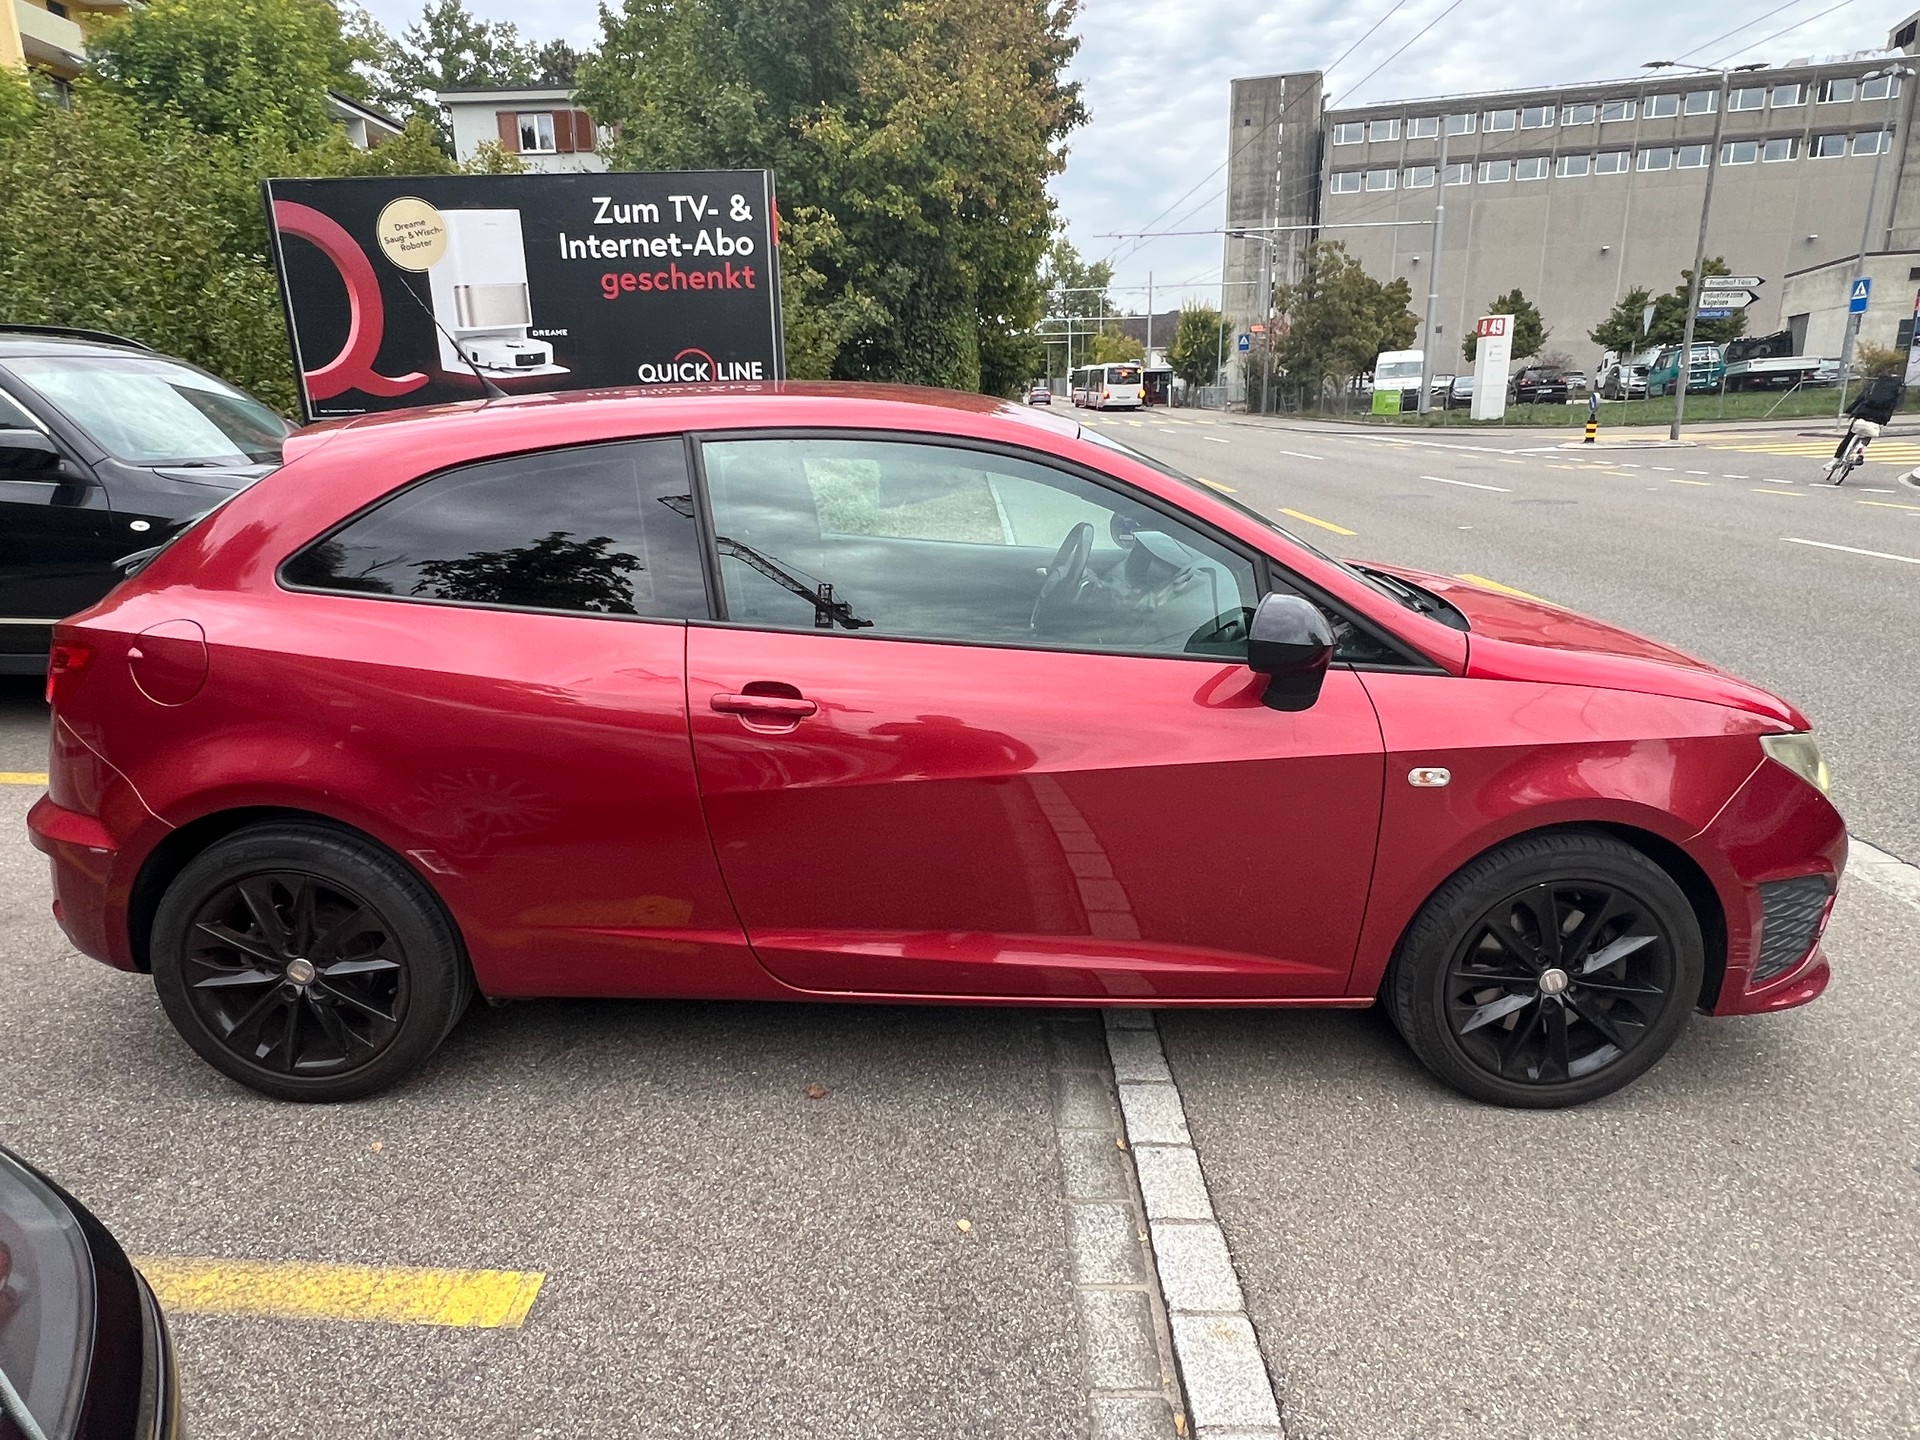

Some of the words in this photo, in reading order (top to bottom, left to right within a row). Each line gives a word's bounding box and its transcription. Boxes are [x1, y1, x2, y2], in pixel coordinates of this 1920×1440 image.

[591, 196, 660, 225] Zum
[667, 194, 719, 223] TV-
[729, 193, 753, 222] &
[394, 219, 426, 231] Dreame
[384, 235, 407, 245] Saug-
[407, 231, 414, 240] &
[414, 226, 443, 237] Wisch-
[558, 227, 755, 260] Internet-Abo
[400, 240, 432, 252] Roboter
[600, 261, 756, 300] geschenkt
[1702, 291, 1744, 299] Industriezone
[532, 328, 568, 337] DREAME
[637, 361, 711, 383] QUICK
[717, 361, 763, 381] LINE
